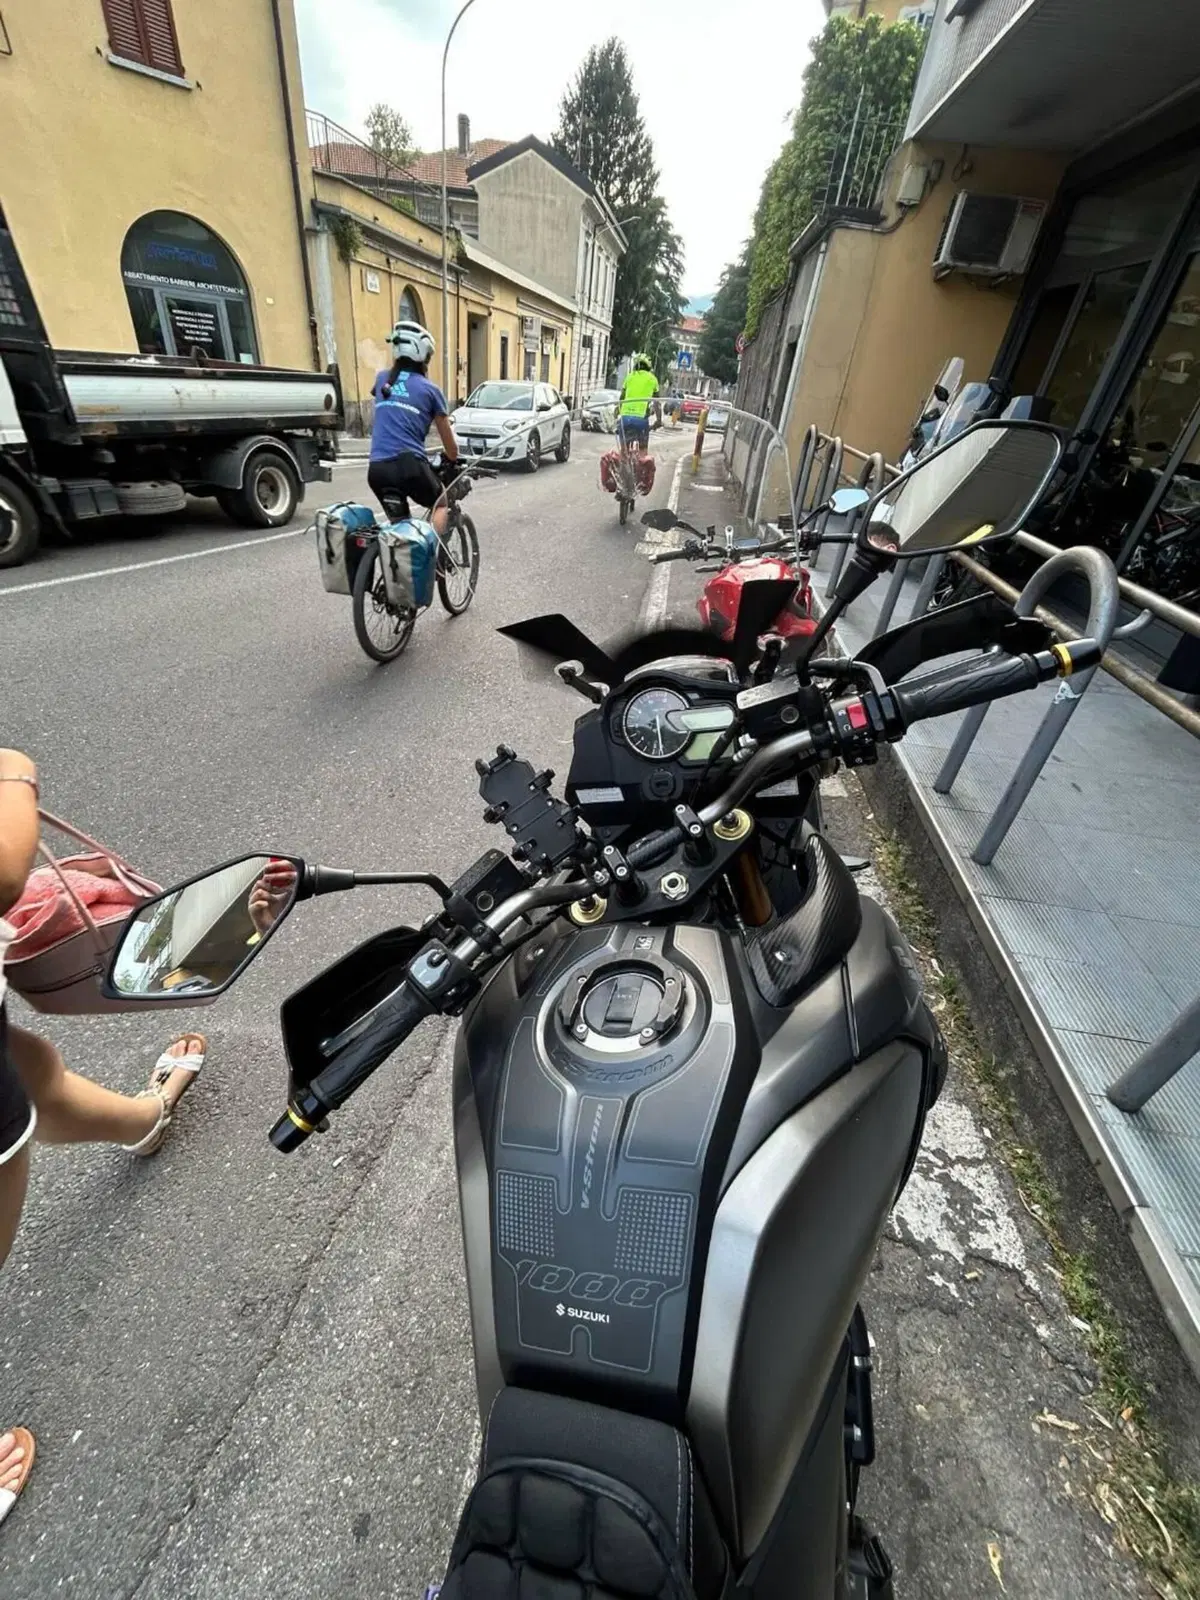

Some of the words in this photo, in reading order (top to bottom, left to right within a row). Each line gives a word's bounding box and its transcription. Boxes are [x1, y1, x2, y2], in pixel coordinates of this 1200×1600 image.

[124, 271, 169, 283] ABBATTIMENTO
[170, 278, 195, 288] BARRIERE
[197, 282, 244, 295] ARCHITETTONICHE
[515, 1259, 667, 1308] 1000
[567, 1306, 610, 1324] SUZUKI
